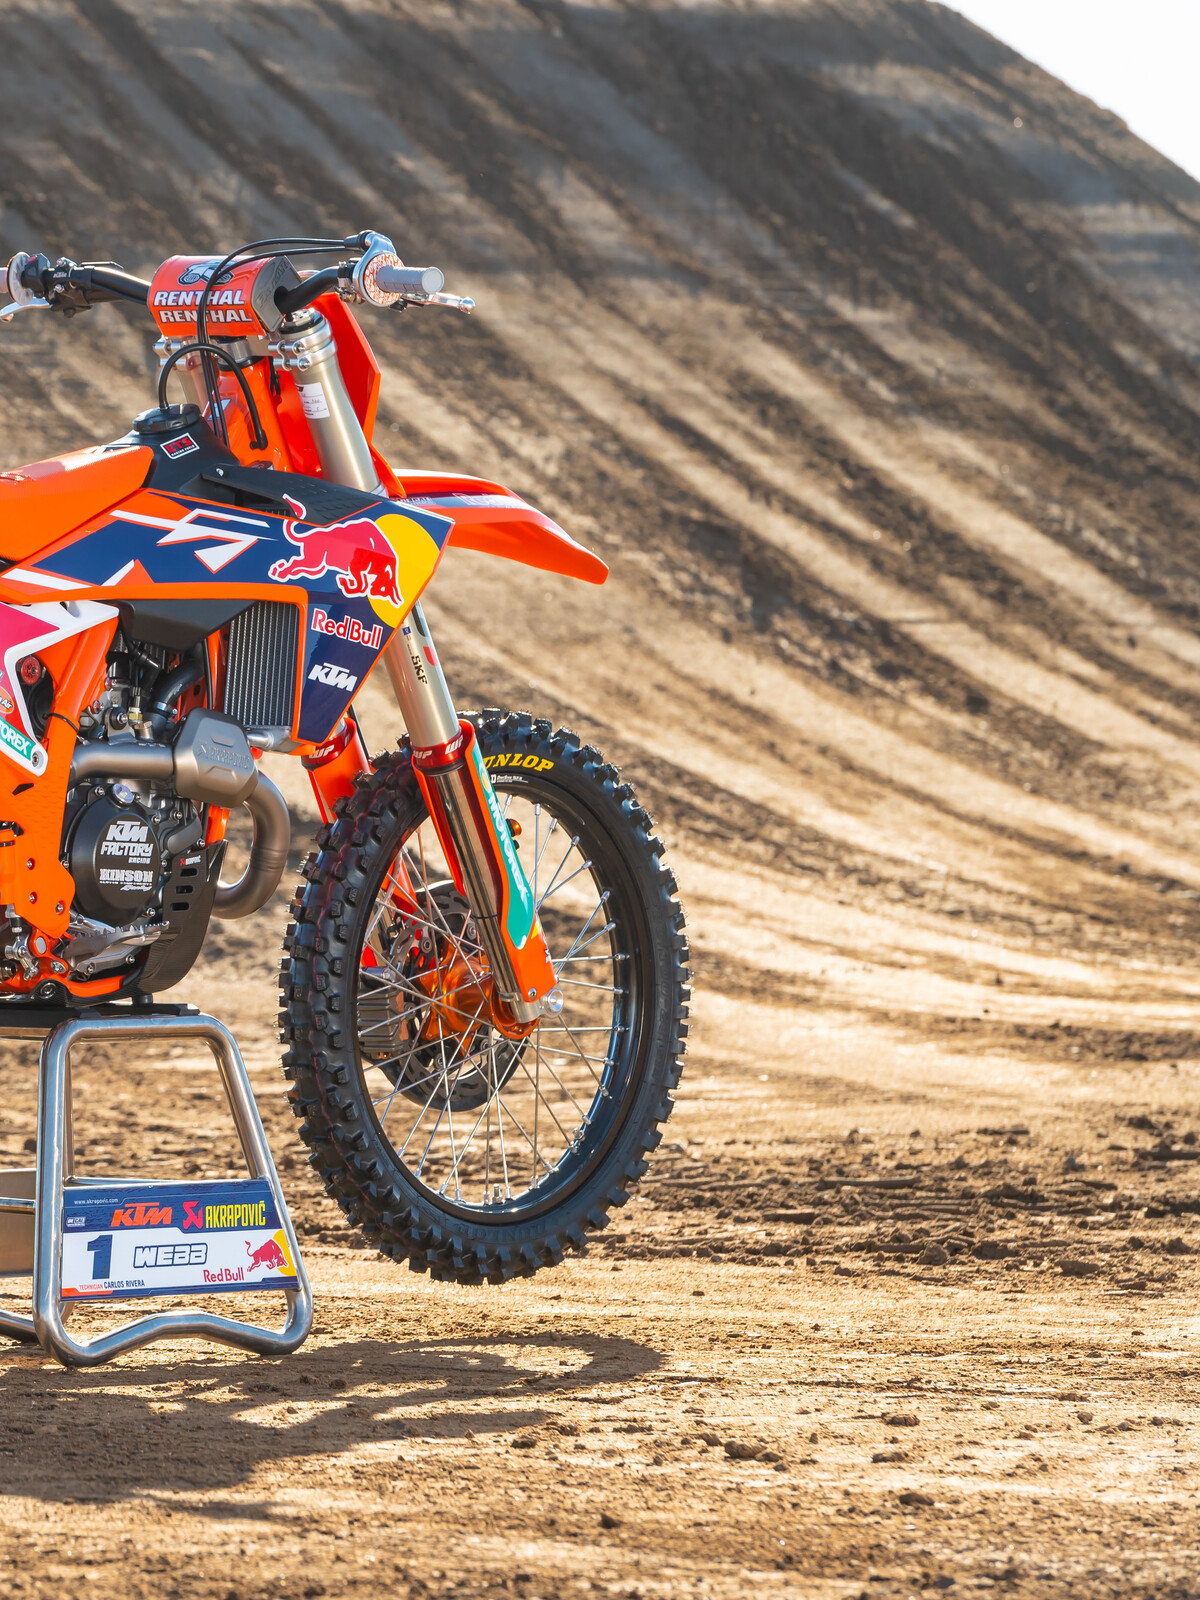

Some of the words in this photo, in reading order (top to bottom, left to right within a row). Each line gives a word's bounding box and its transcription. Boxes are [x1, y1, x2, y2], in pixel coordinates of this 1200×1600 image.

[165, 436, 192, 453] ETS
[311, 608, 350, 639] Red
[349, 618, 384, 649] Bull
[308, 662, 358, 692] KTM
[411, 655, 428, 684] SKF
[1, 697, 13, 710] Air
[483, 753, 554, 772] UNLOP
[106, 821, 148, 842] KTM
[100, 842, 153, 857] FACTORY
[487, 794, 529, 901] MOTOREX
[100, 868, 153, 882] HINSON
[110, 1202, 173, 1227] KTM
[87, 1234, 113, 1280] 1
[133, 1243, 208, 1268] WEBB
[103, 1280, 125, 1289] CARLOS
[125, 1279, 145, 1288] RIVERA
[203, 1268, 224, 1283] Red
[224, 1266, 244, 1282] Bull
